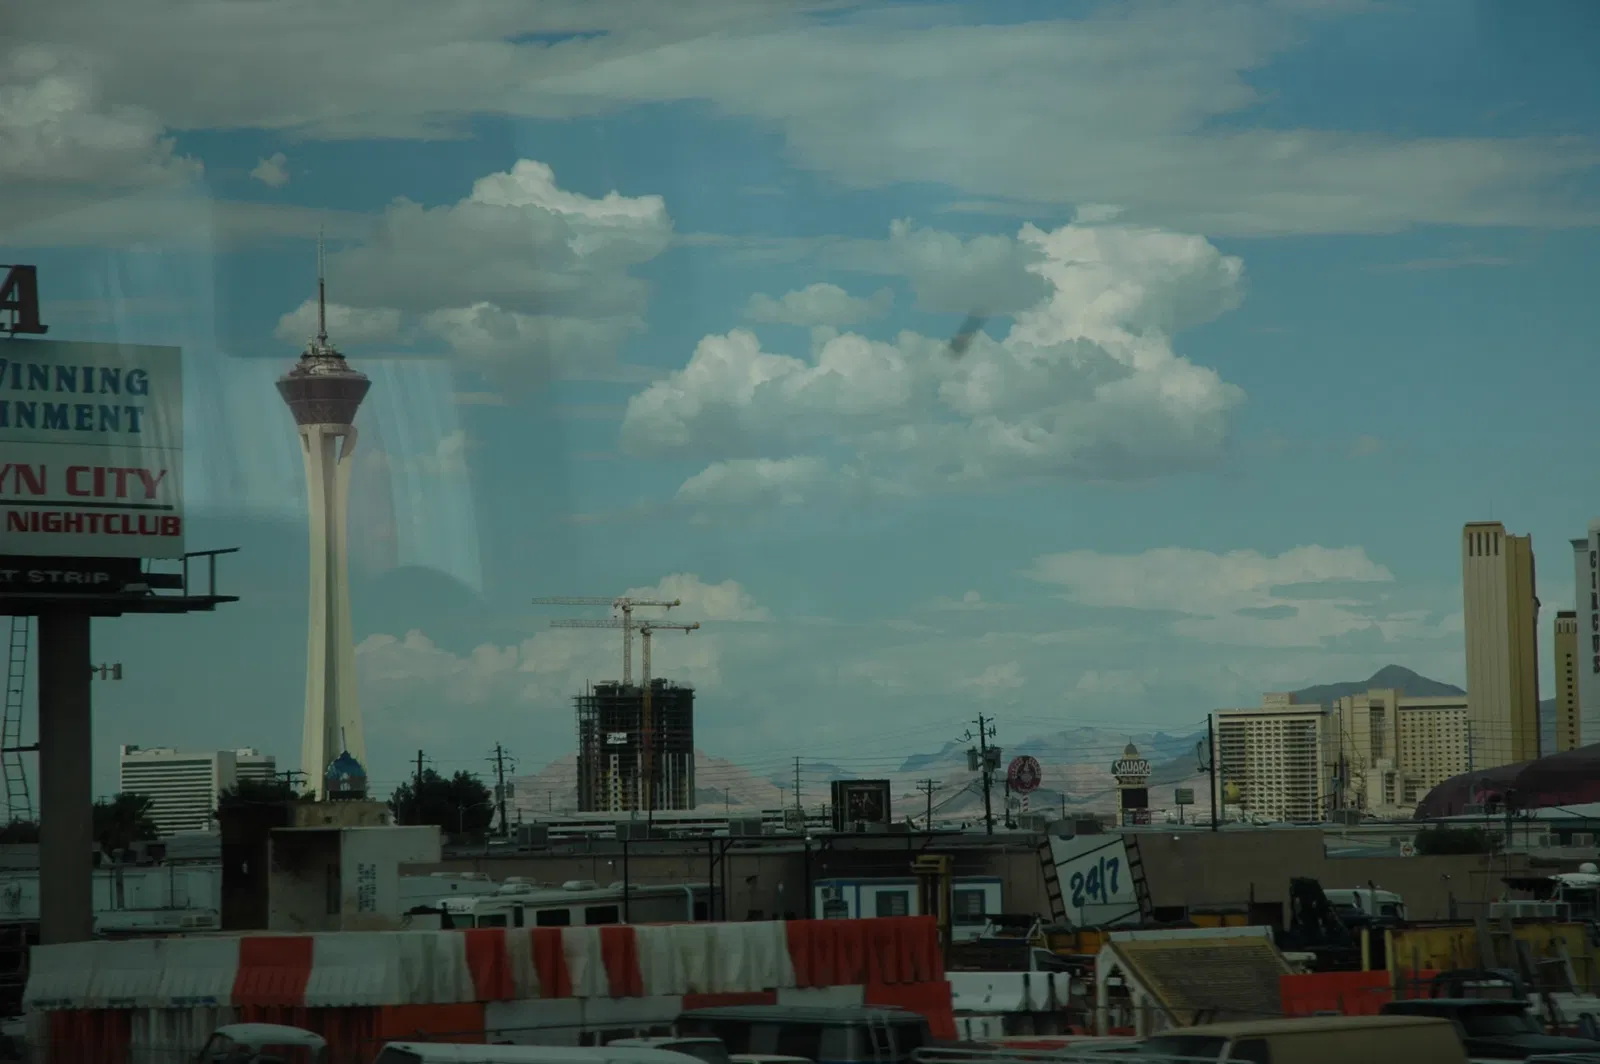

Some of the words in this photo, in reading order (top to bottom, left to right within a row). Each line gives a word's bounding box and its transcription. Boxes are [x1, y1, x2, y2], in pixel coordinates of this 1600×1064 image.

[0, 358, 149, 396] INNING
[66, 465, 167, 499] CITY
[7, 511, 181, 537] NIGHTCLUB
[27, 569, 110, 584] STRIP
[1590, 550, 1600, 674] CIRCUS
[1115, 760, 1152, 775] SAHARA
[1071, 856, 1119, 908] 24/7
